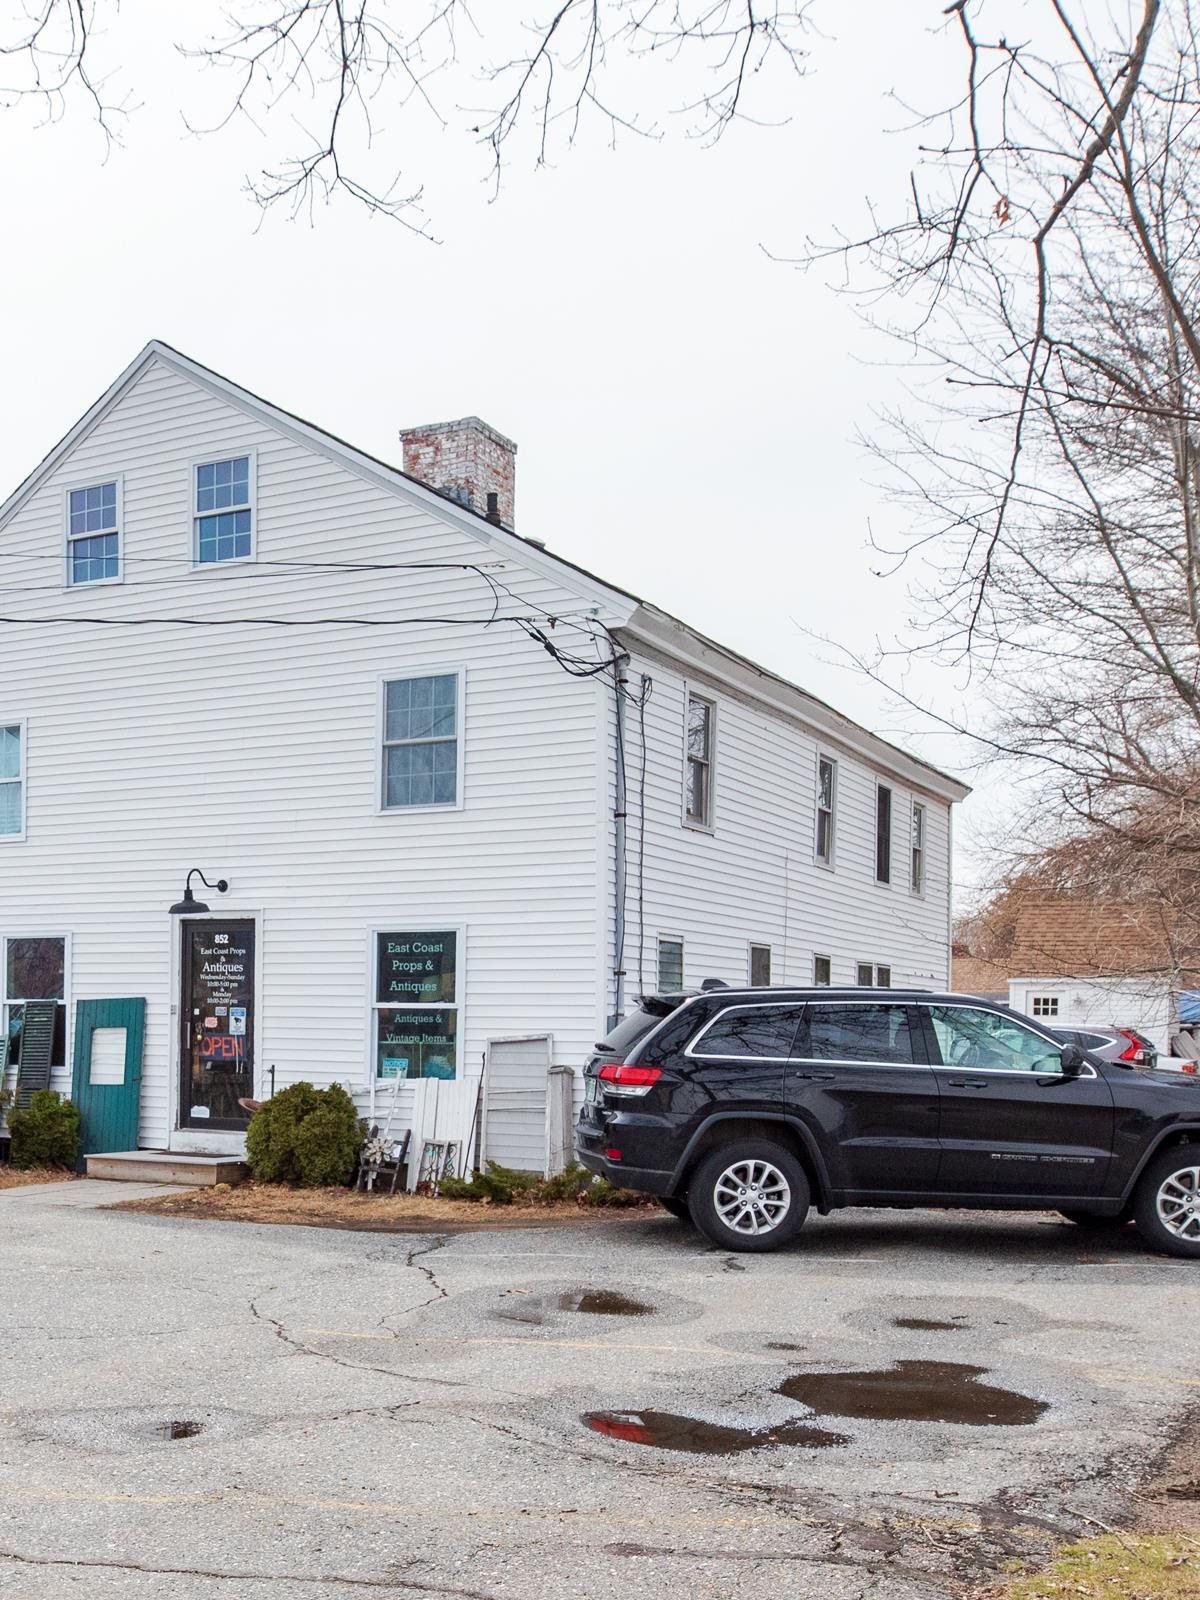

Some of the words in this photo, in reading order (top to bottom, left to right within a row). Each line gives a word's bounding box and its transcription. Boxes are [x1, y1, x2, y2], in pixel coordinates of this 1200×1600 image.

[214, 934, 229, 944] 852
[200, 947, 213, 955] East
[213, 947, 229, 955] Coast
[229, 947, 246, 957] Props
[388, 942, 411, 953] East
[412, 942, 443, 953] Coast
[202, 961, 244, 975] Antiques
[392, 960, 423, 973] Props
[425, 960, 434, 971] &
[389, 980, 438, 993] Antiques
[394, 1014, 434, 1024] Antiques
[435, 1014, 443, 1023] &
[386, 1033, 420, 1044] Vintage
[421, 1033, 447, 1043] Items
[201, 1036, 243, 1056] OPEN
